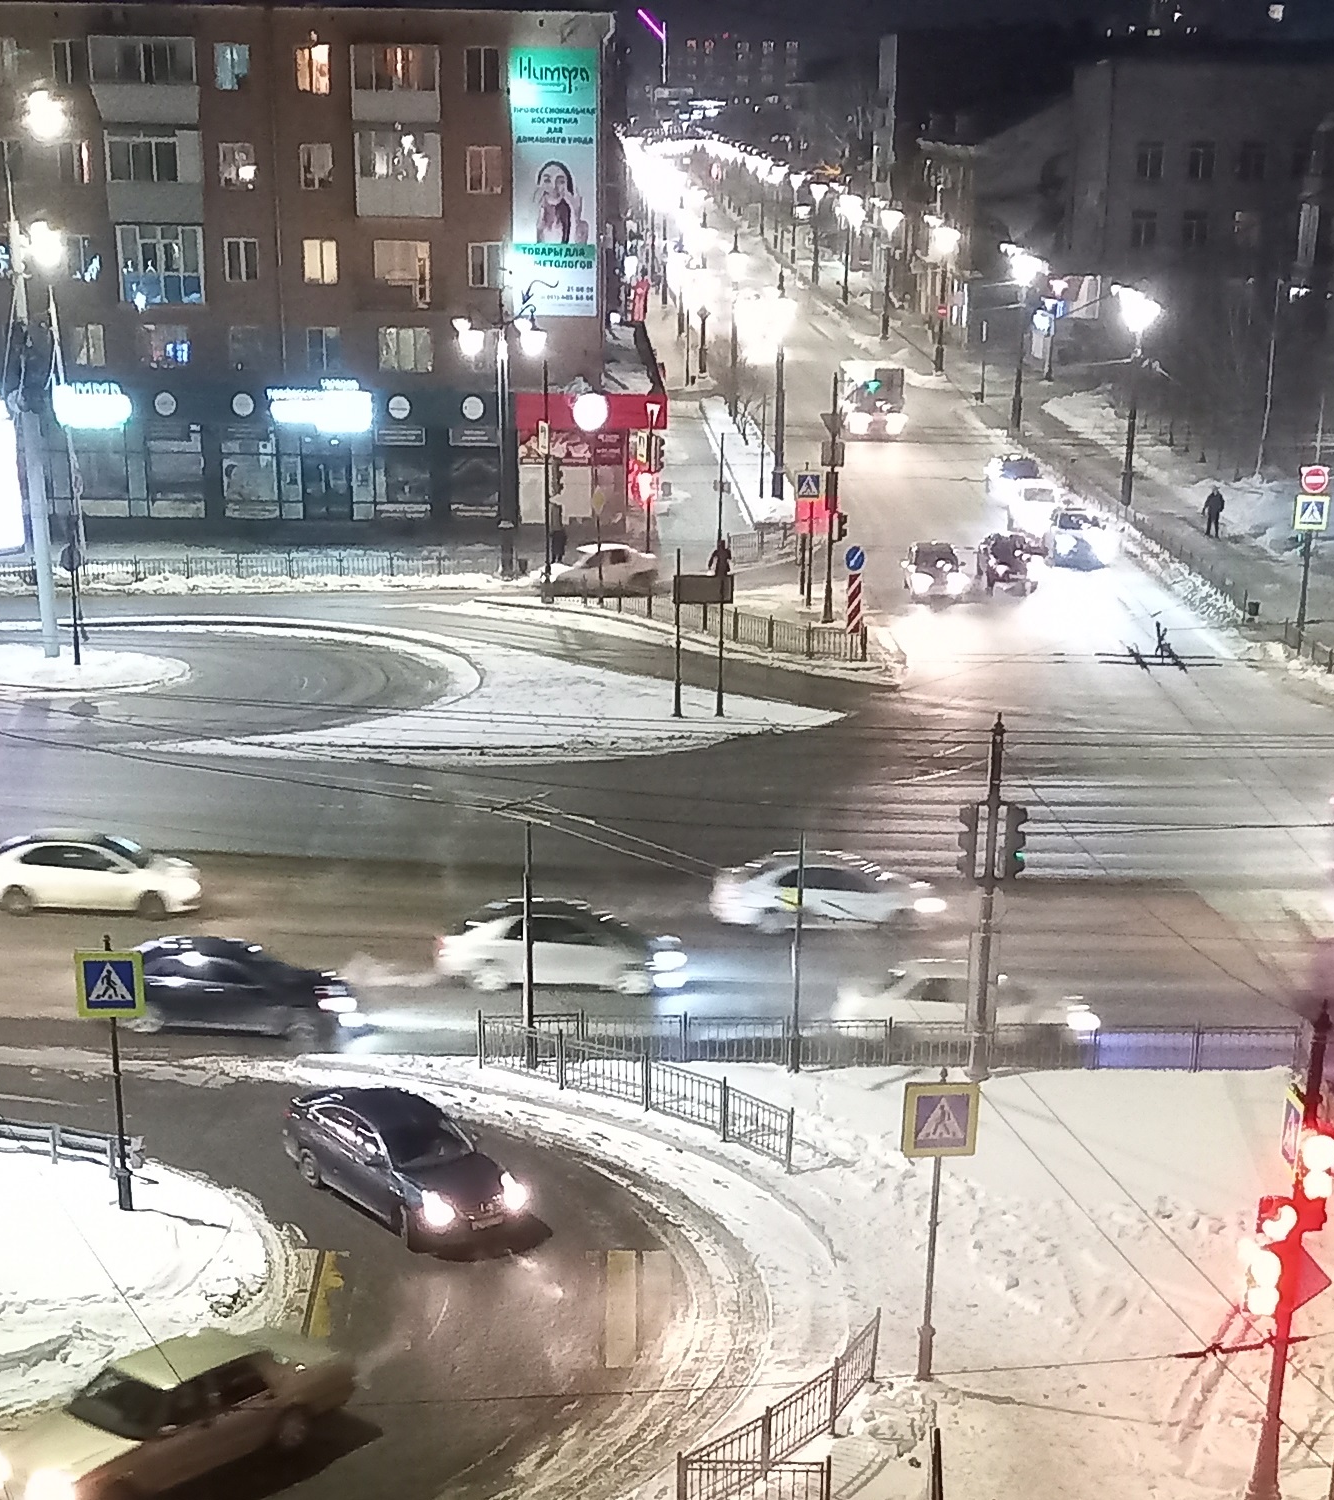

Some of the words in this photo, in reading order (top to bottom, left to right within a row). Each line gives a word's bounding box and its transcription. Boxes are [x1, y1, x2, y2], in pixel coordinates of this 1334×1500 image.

[531, 116, 579, 125] КОСМЕТИКА
[521, 246, 563, 258] ТОВАРЫ
[563, 247, 586, 259] ДЛЯ
